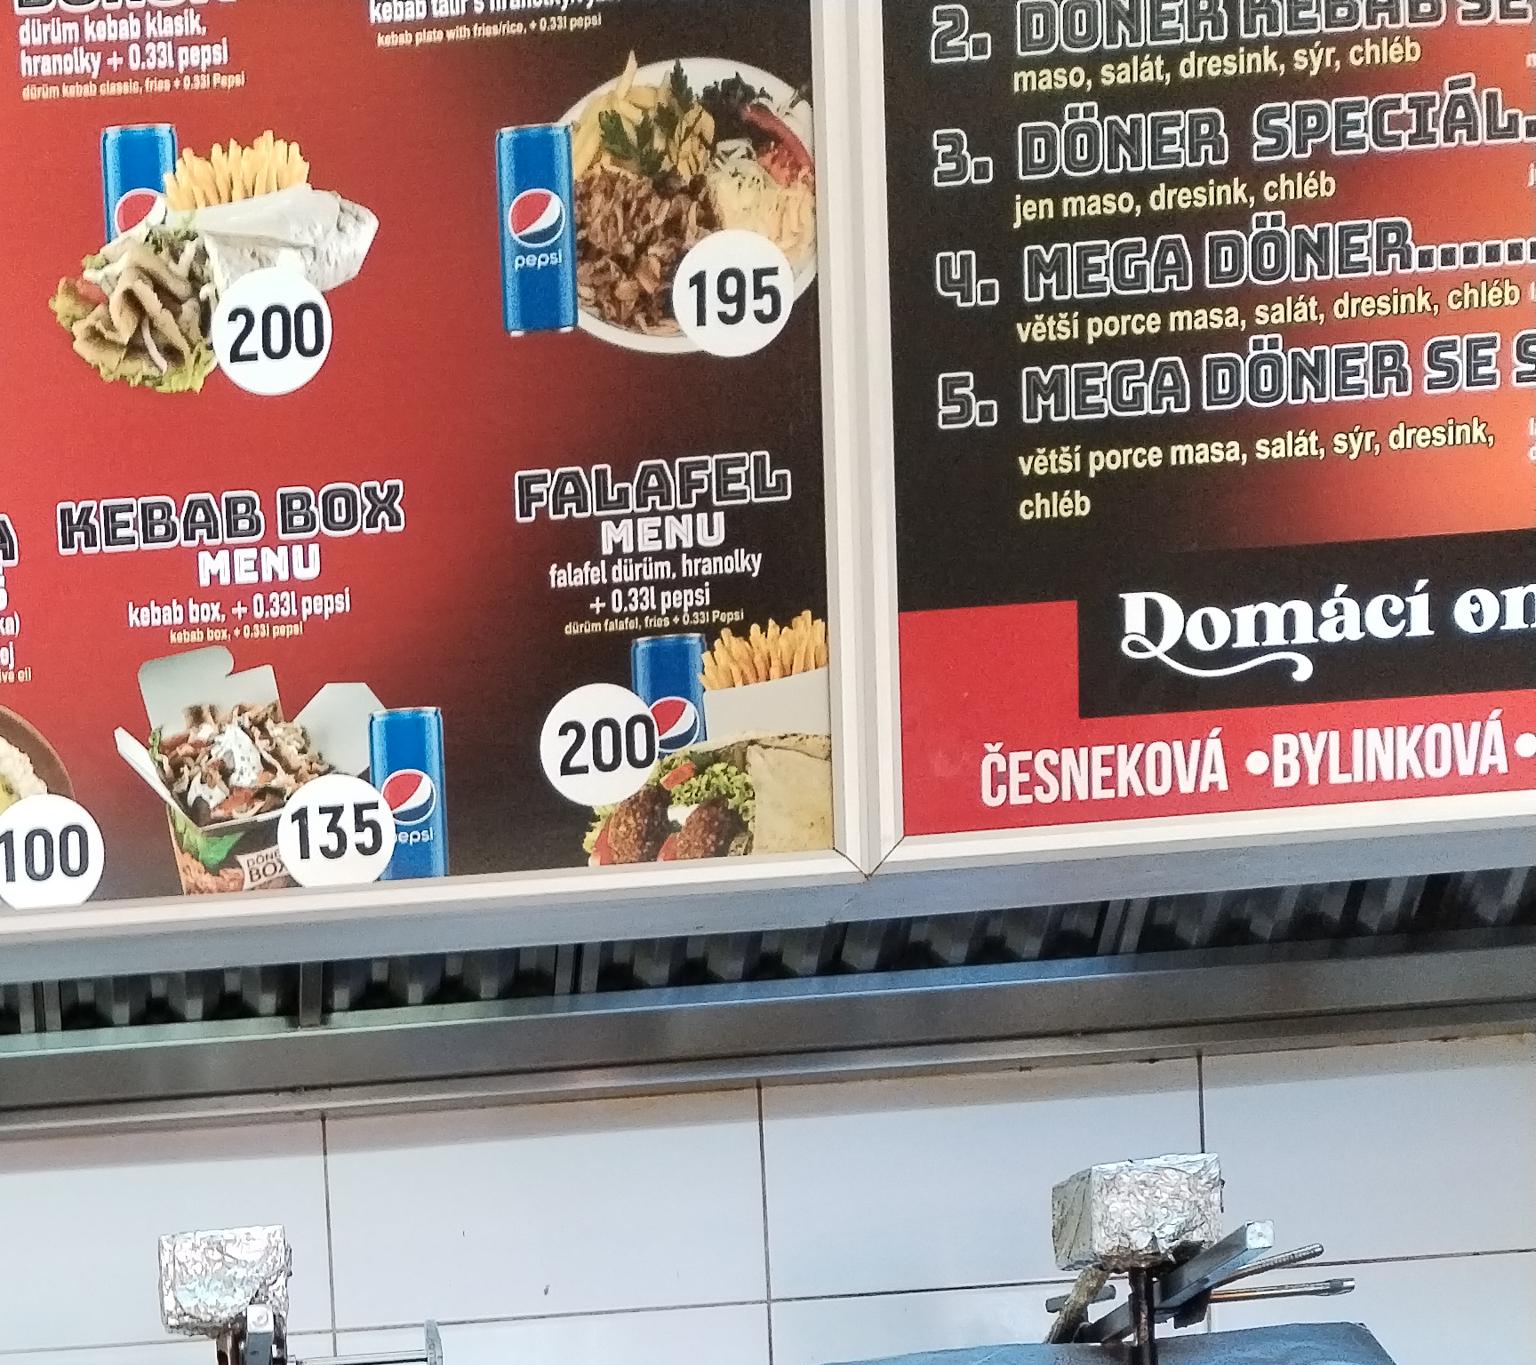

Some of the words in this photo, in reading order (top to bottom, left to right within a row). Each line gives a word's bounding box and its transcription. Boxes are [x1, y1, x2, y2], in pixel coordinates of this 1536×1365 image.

[19, 17, 79, 46] dürüm
[84, 12, 140, 42] kebab
[145, 8, 206, 38] klasik,
[377, 30, 413, 47] kebab
[415, 30, 444, 49] plate
[445, 24, 470, 40] with
[931, 4, 991, 64] 2.
[20, 47, 101, 78] hranolky
[107, 51, 123, 71] +
[178, 37, 229, 73] pepsi
[1013, 66, 1093, 94] maso,
[1100, 54, 1171, 85] salát,
[1180, 45, 1285, 79] dresink,
[1292, 41, 1341, 73] sýr,
[1350, 34, 1420, 66] chléb
[933, 129, 993, 187] 3.
[1018, 101, 1229, 180] DÖNER
[1012, 194, 1054, 228] jen
[1063, 193, 1141, 217] maso,
[1149, 177, 1255, 212] dresink,
[1264, 174, 1335, 201] chléb
[515, 248, 563, 272] pepsi
[936, 250, 999, 308] 4.
[1024, 234, 1193, 303] MEGA
[688, 265, 783, 328] 195
[1016, 314, 1080, 344] větší
[1087, 311, 1162, 345] porce
[1169, 305, 1247, 333] masa,
[1255, 295, 1326, 328] salát,
[1333, 288, 1440, 323] dresink,
[1448, 278, 1520, 311] chléb
[227, 300, 325, 362] 200
[937, 371, 998, 429] 5.
[1022, 356, 1190, 424] MEGA
[1202, 332, 1411, 414] DÖNER
[1423, 331, 1500, 394] SE
[1018, 446, 1082, 477] větší
[1089, 444, 1163, 478] porce
[1170, 439, 1248, 467] masa,
[1255, 431, 1326, 463] salát,
[1333, 424, 1382, 458] sýr,
[1388, 416, 1494, 451] dresink,
[514, 450, 792, 522] FALAFEL
[1019, 489, 1091, 520] chléb
[56, 489, 266, 556] KEBAB
[276, 479, 405, 540] BOX
[601, 511, 725, 555] MENU
[198, 543, 321, 587] MENU
[549, 556, 607, 588] falafel
[612, 555, 676, 586] dürüm,
[682, 549, 762, 578] hranolky
[128, 598, 183, 628] kebab
[188, 599, 226, 624] box,
[232, 601, 248, 620] +
[302, 587, 351, 620] pepsi
[564, 618, 602, 635] dürüm
[604, 616, 642, 632] falafel,
[644, 614, 670, 629] fries
[712, 608, 744, 624] Pepsi
[590, 597, 605, 614] +
[661, 581, 710, 614] pepsi
[169, 625, 204, 644] kebab
[1119, 579, 1434, 683] Domácí
[558, 714, 656, 776] 200
[981, 727, 1228, 808] ČESNEKOVÁ
[290, 801, 383, 860] 135
[396, 826, 433, 845] epsi
